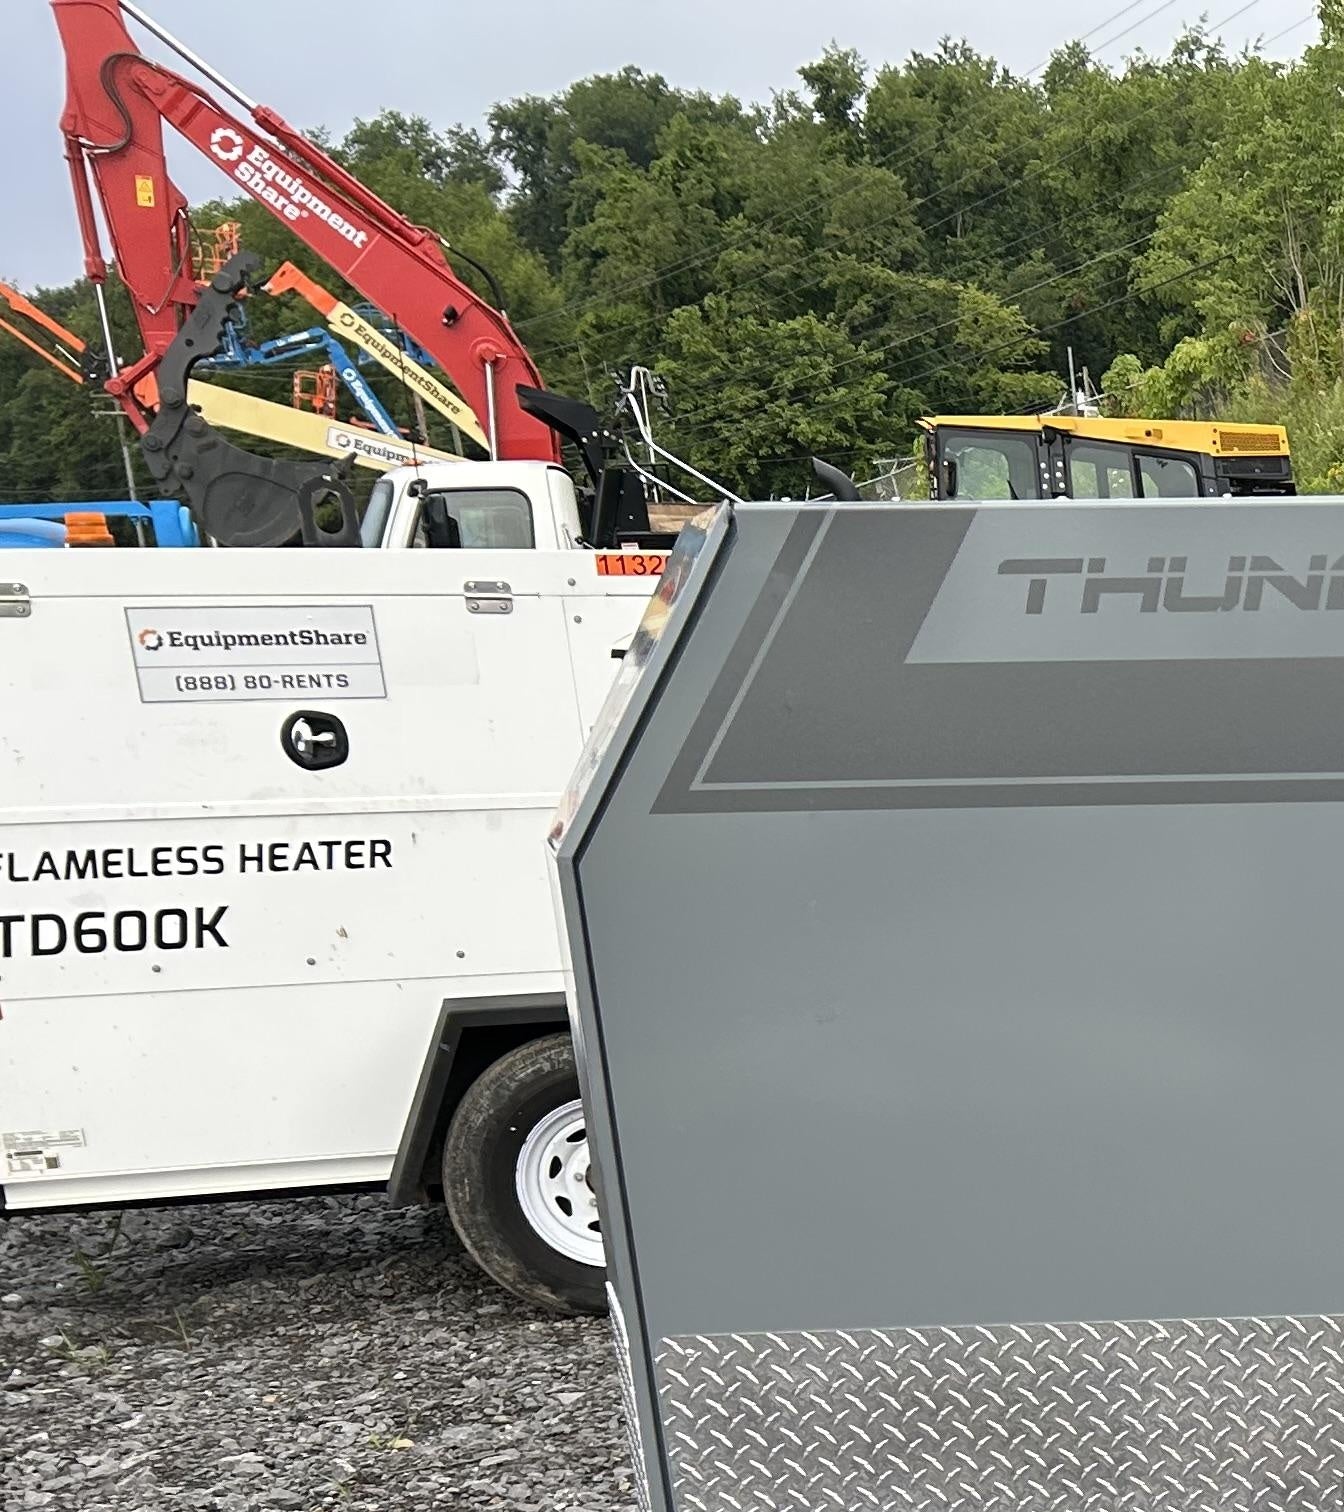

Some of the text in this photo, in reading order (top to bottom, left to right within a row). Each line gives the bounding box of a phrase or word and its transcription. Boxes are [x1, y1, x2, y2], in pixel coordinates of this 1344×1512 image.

[233, 161, 301, 221] Share
[246, 144, 369, 249] Equipment
[354, 323, 462, 415] EquipmentShare
[598, 555, 672, 576] 1132
[166, 629, 368, 651] EquipmentShare
[176, 673, 350, 692] (888) 80-RENTS
[239, 839, 393, 874] HEATER
[0, 905, 230, 959] TD600K
